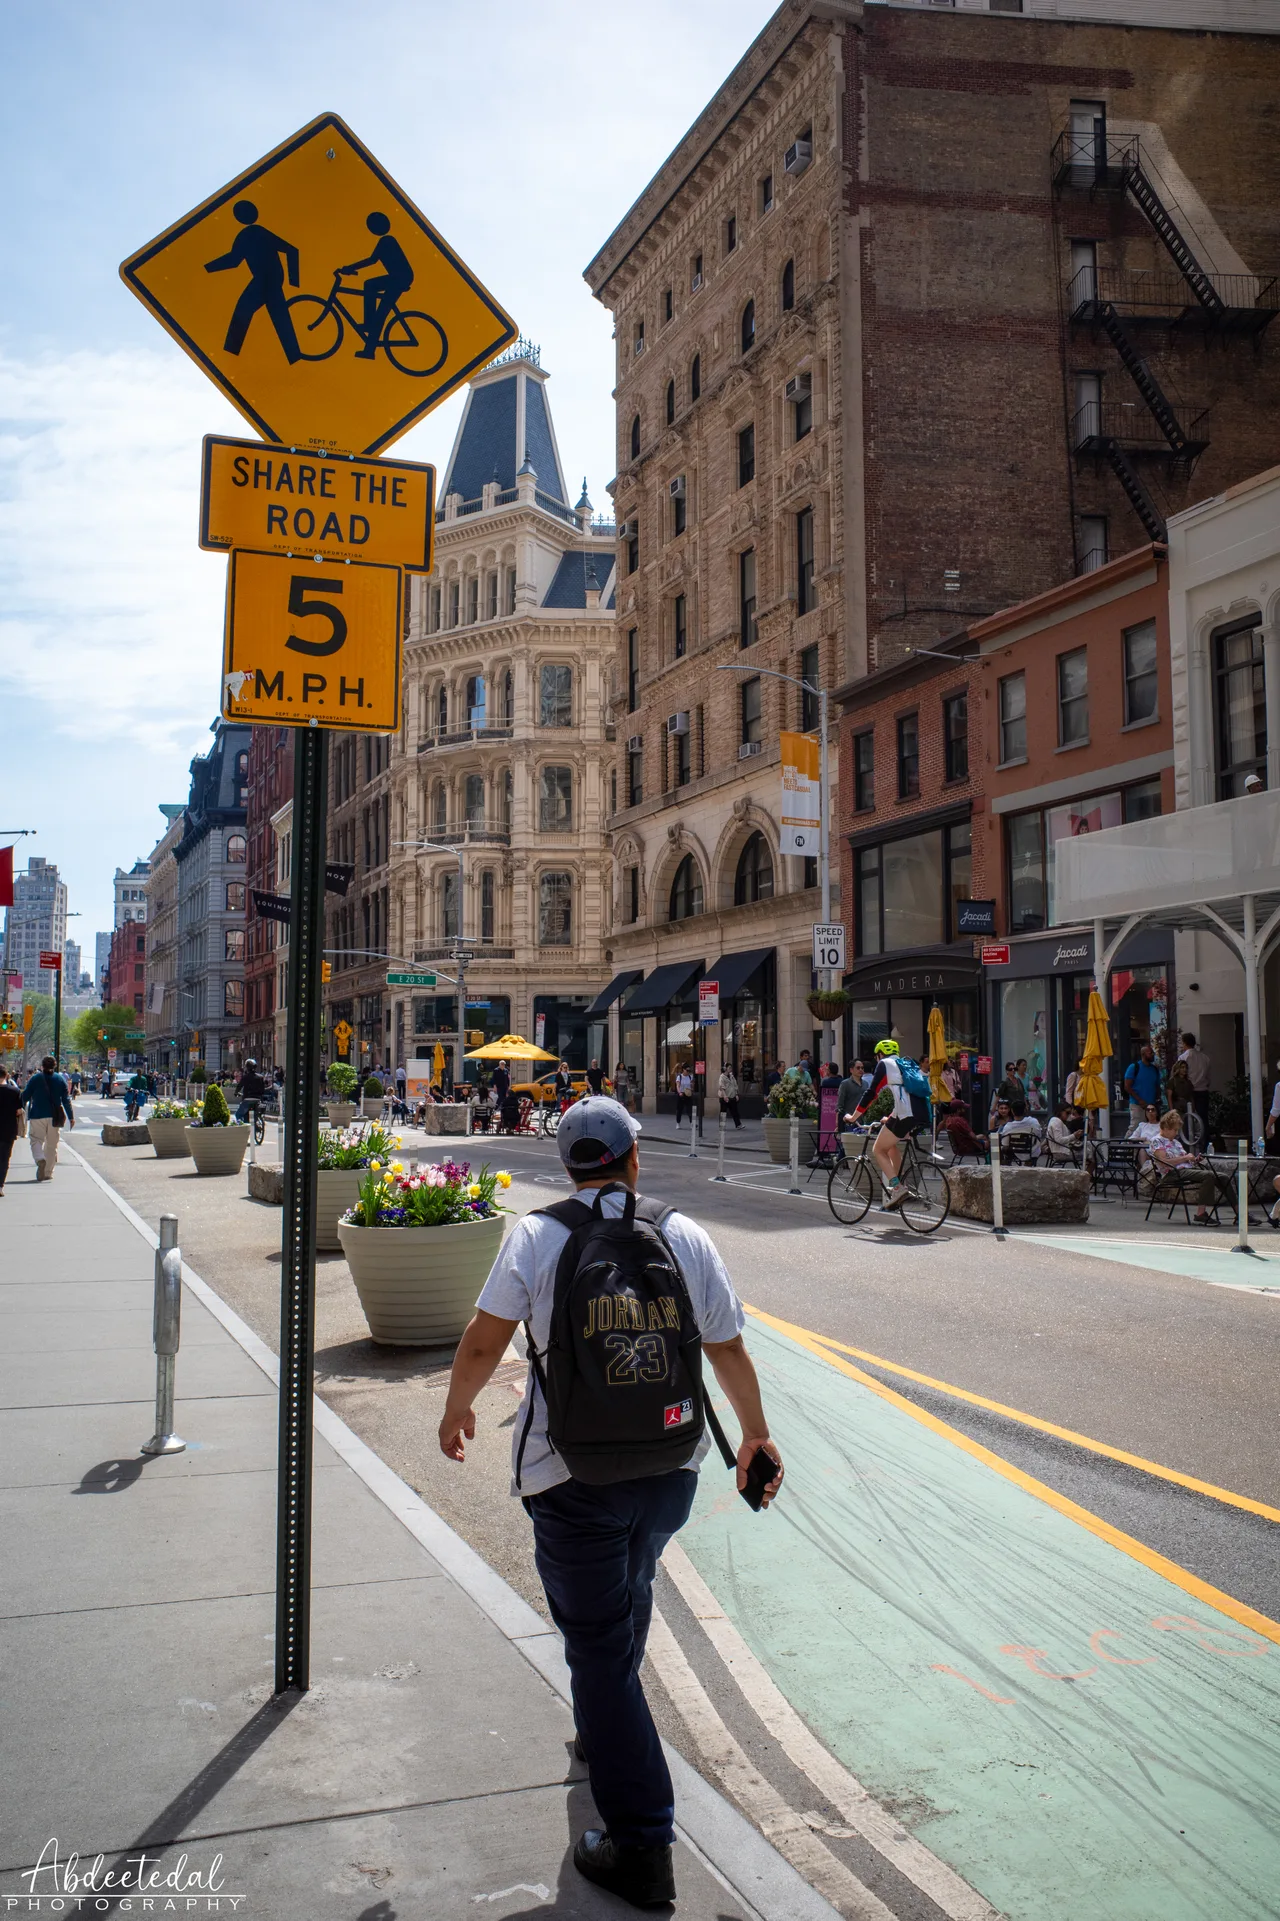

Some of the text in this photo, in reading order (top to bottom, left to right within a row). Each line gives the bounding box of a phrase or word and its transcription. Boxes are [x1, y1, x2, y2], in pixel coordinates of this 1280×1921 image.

[231, 456, 408, 508] SHARE THE
[267, 503, 371, 545] ROAD
[305, 548, 364, 559] TRANSPORTATION
[284, 575, 349, 657] 5
[254, 668, 374, 709] M.P.H.
[304, 713, 353, 722] TRANSPORTATION
[960, 908, 991, 925] jacadi
[816, 927, 843, 936] SPEED
[818, 937, 840, 946] LIMIT
[820, 948, 840, 966] 10
[1053, 944, 1088, 967] jacadi
[399, 975, 425, 984] E 20 St
[874, 974, 945, 993] MADERA
[583, 1295, 681, 1339] JORDAN
[605, 1334, 669, 1384] 23
[682, 1401, 691, 1412] 23
